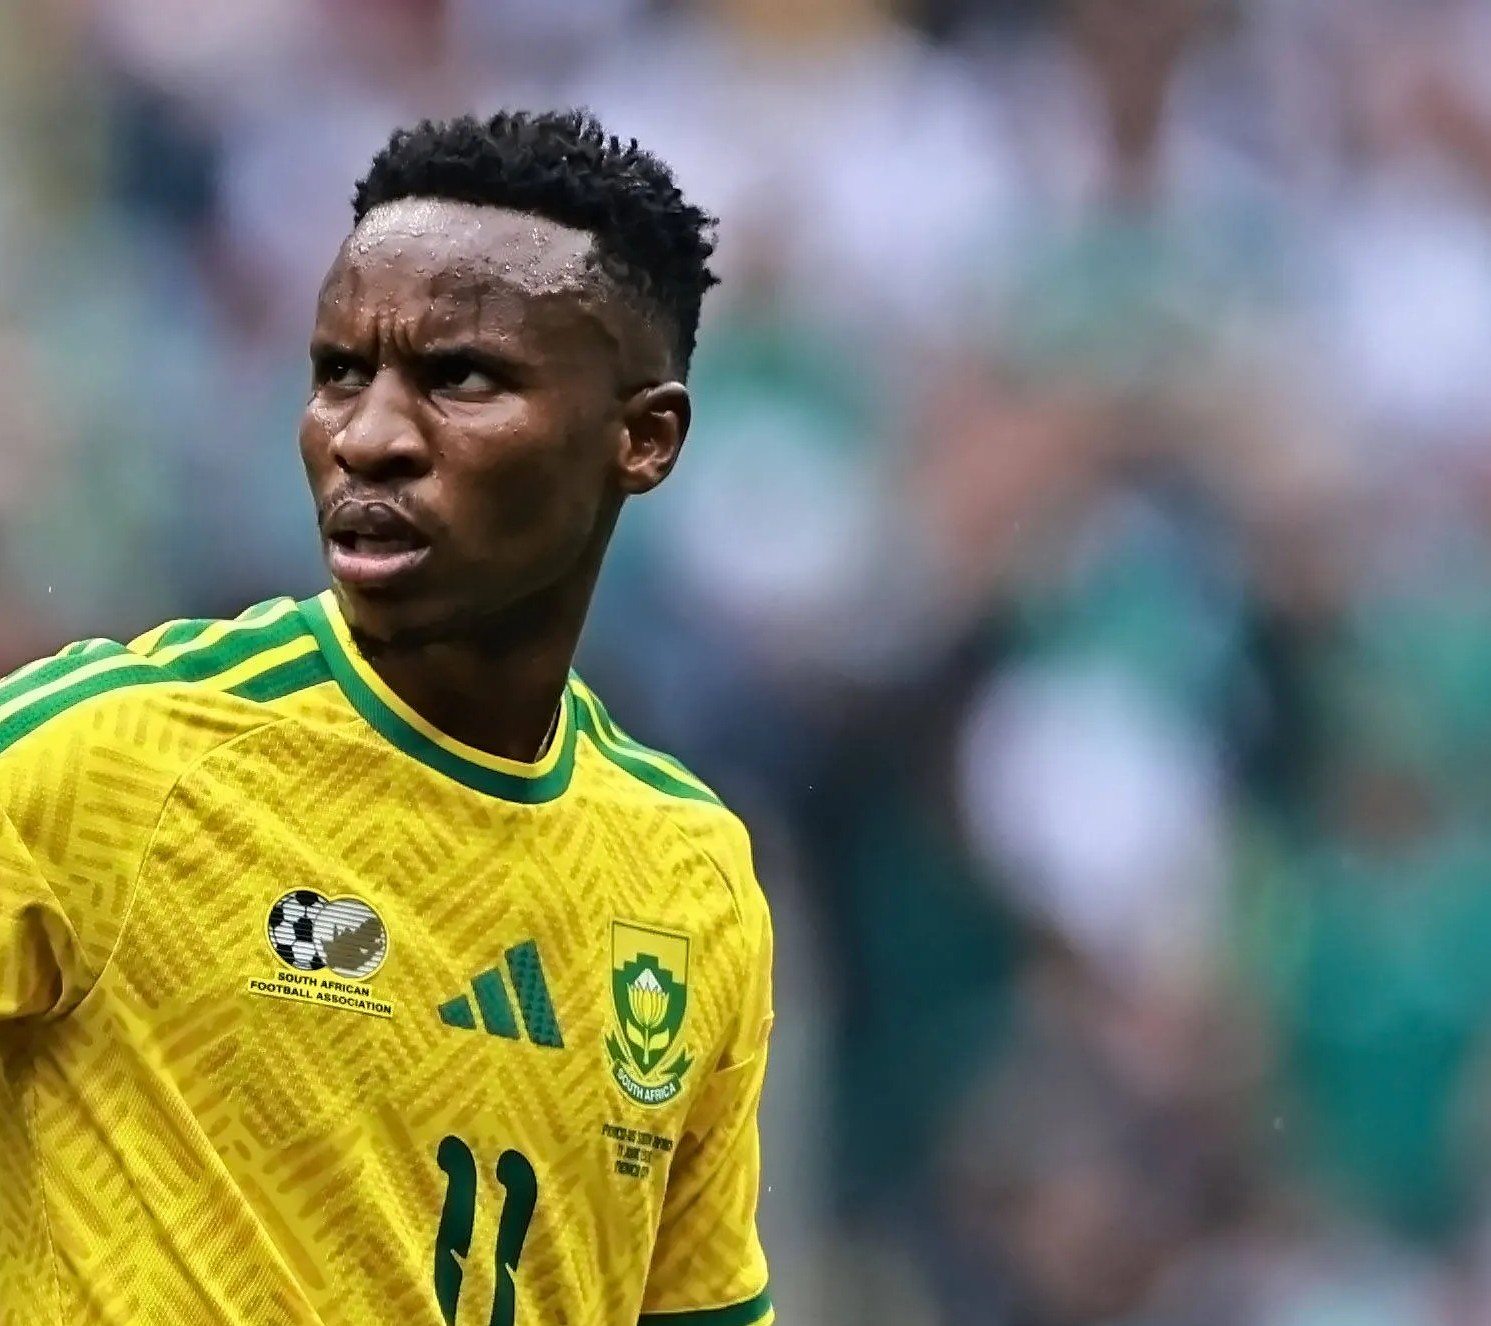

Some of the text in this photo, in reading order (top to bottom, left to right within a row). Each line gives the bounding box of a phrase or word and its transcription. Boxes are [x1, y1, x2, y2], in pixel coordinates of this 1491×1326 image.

[250, 980, 392, 1014] FOOTBALL ASSOCIATION
[278, 971, 370, 997] SOUTH AFRICAN
[617, 1068, 677, 1101] SOUTH AFRICA
